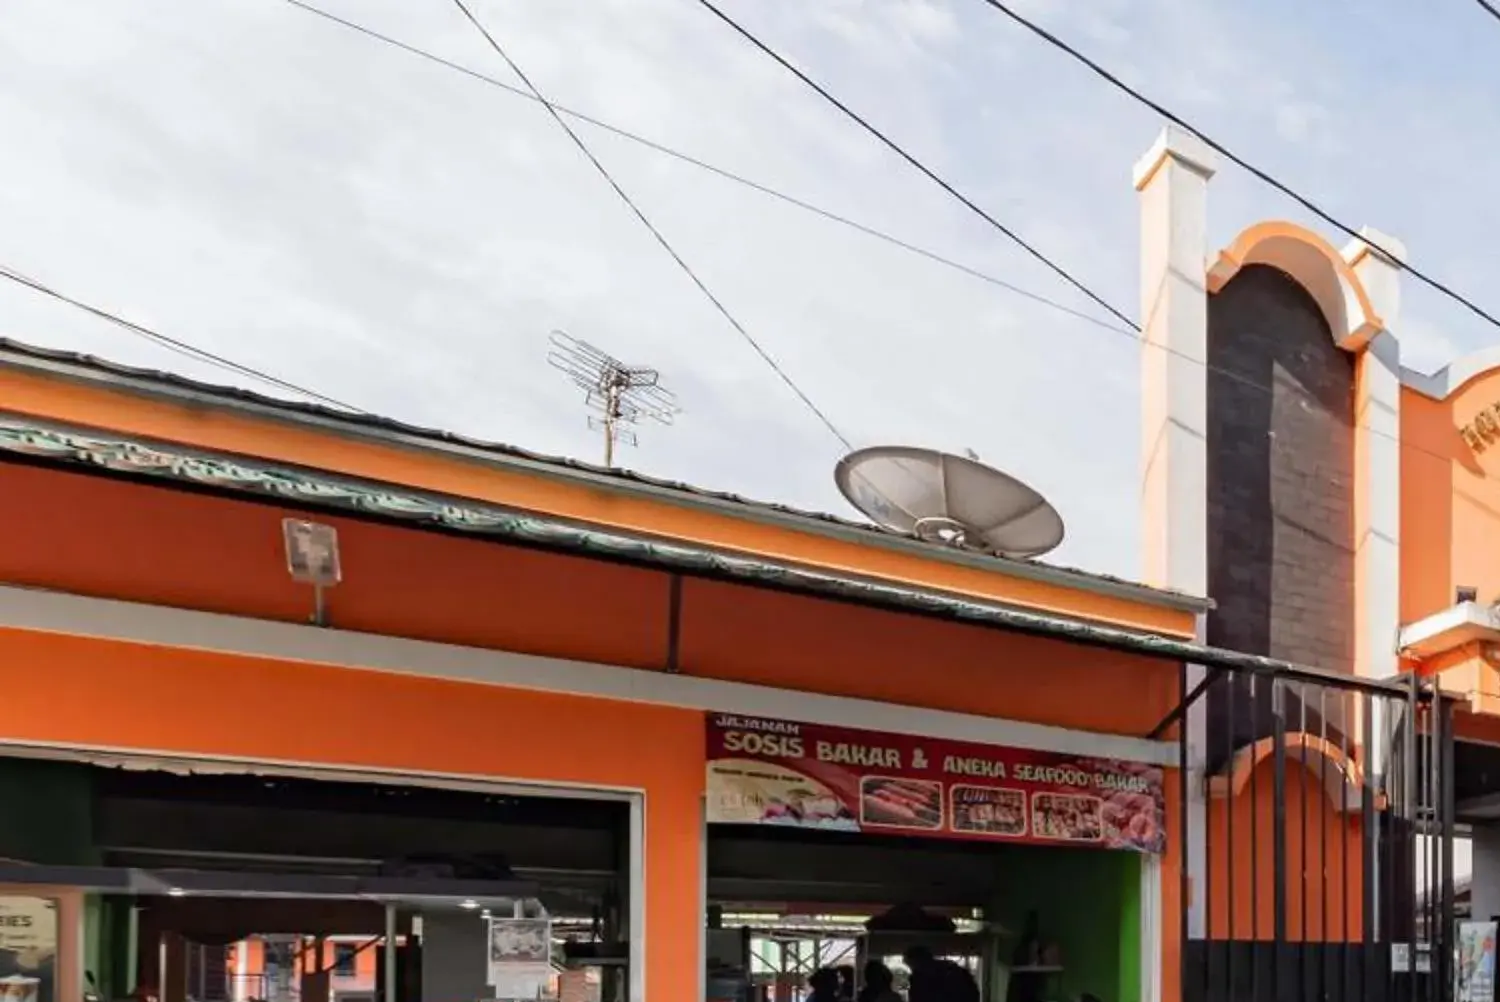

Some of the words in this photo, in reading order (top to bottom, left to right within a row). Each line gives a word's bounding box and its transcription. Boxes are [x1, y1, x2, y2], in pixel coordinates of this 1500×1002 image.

[723, 731, 804, 758] SOSIS
[816, 740, 901, 769] BAKAR
[911, 748, 928, 769] &
[943, 755, 1006, 779] ANEKA
[1012, 763, 1089, 787] SEAFOOD
[1093, 774, 1149, 794] BAKAR
